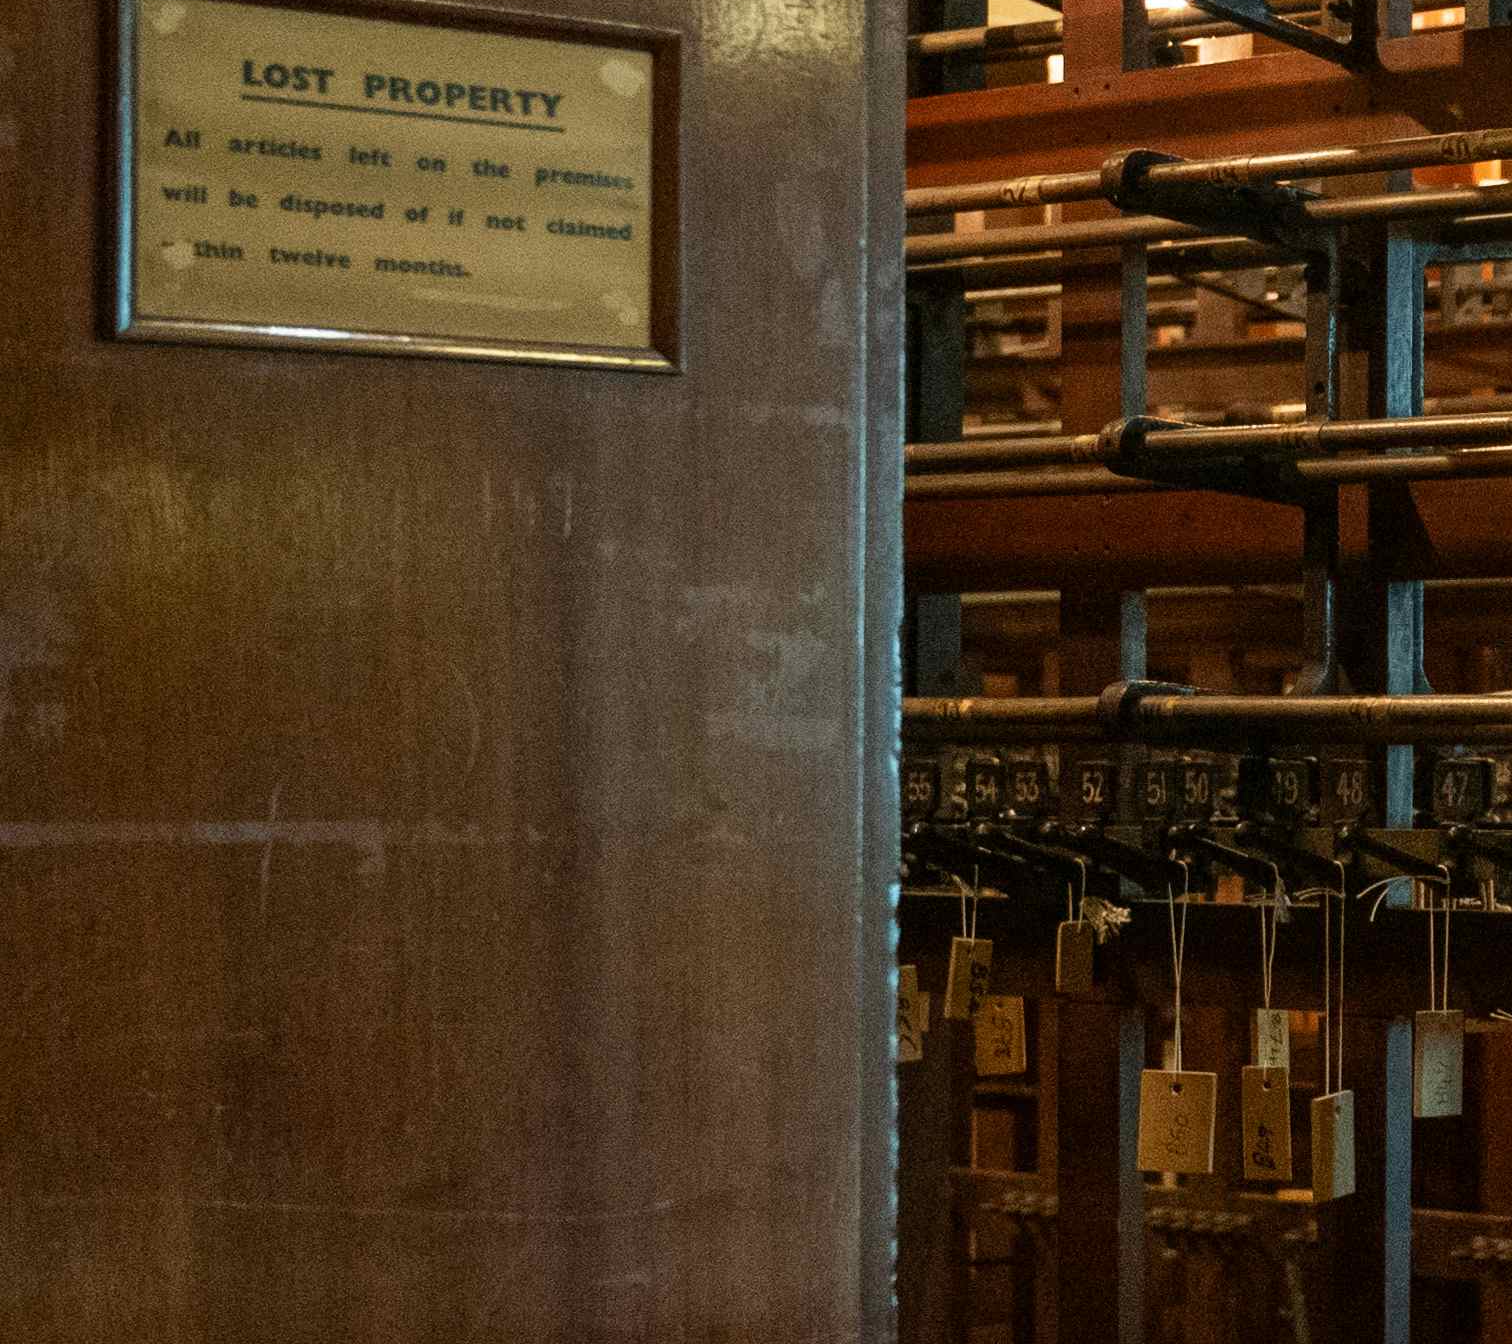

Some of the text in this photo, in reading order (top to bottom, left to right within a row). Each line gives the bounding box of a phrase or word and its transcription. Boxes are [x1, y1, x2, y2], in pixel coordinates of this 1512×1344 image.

[241, 59, 564, 119] LOST PROPERTY
[164, 128, 634, 192] All articles left on the premises
[161, 182, 632, 242] will be disposed of if not claimed
[162, 240, 471, 280] thin twelve months.
[1015, 771, 1040, 803] 53
[1081, 771, 1104, 803] 52
[1147, 771, 1167, 805] 51
[1184, 770, 1209, 804] 50
[1336, 771, 1364, 806] 48
[1441, 770, 1470, 806] 47
